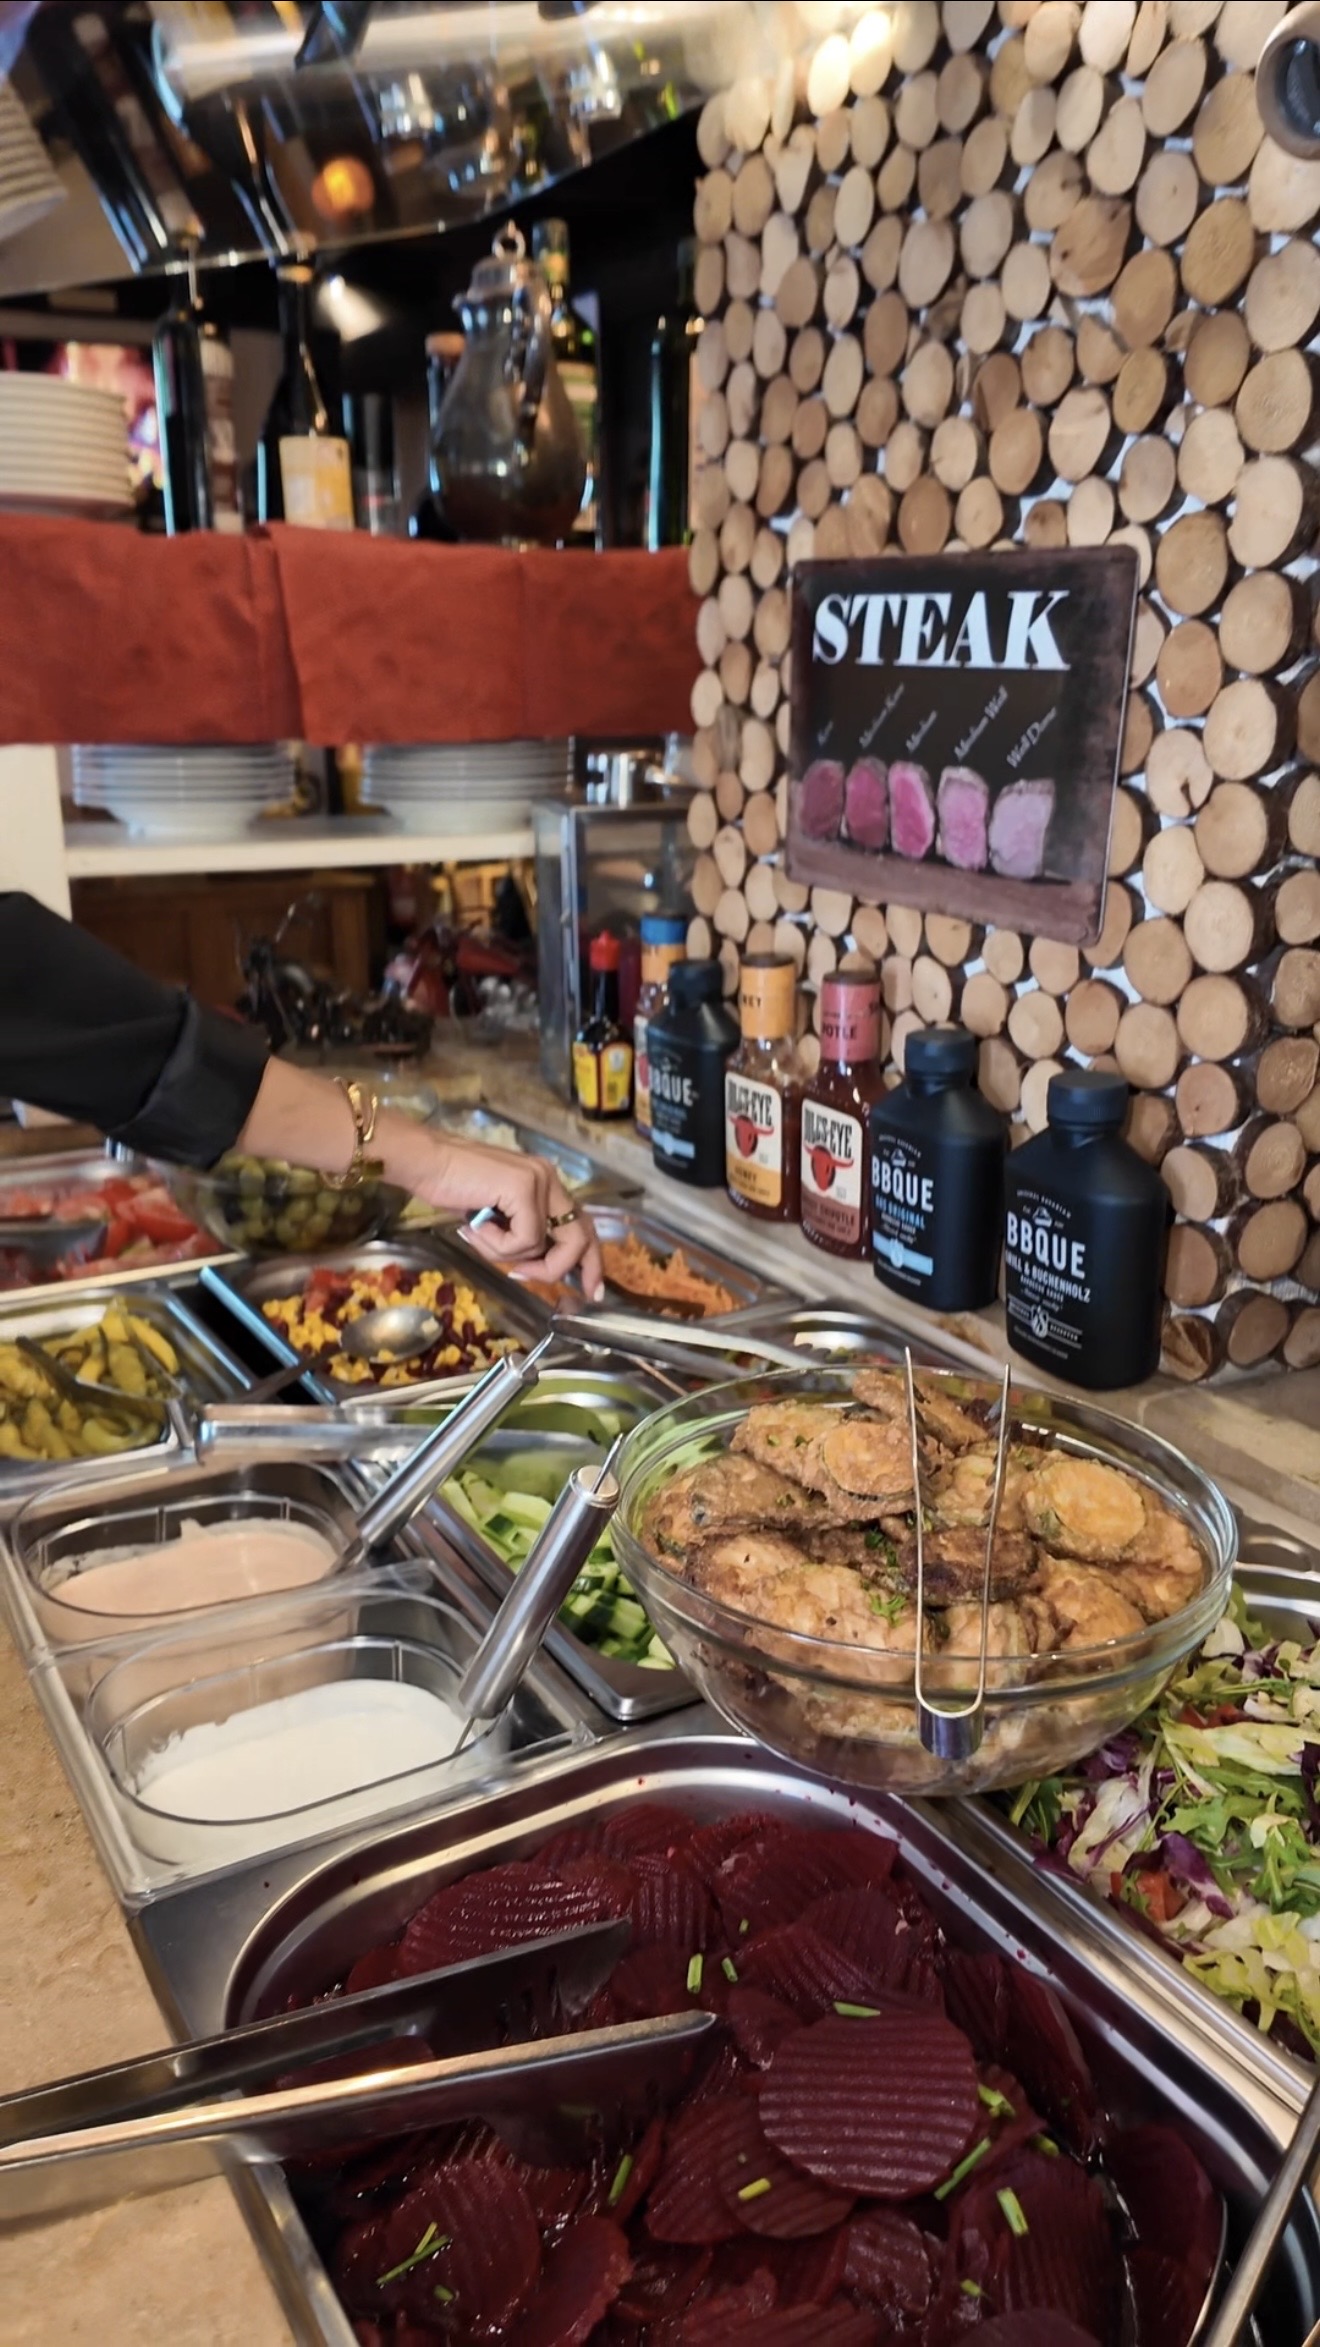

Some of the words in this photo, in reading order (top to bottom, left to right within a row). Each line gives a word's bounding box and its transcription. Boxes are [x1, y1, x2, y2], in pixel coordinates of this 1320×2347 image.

[812, 590, 1071, 671] STEAK
[871, 1155, 934, 1213] BBQUE
[1006, 1210, 1086, 1280] BBQUE
